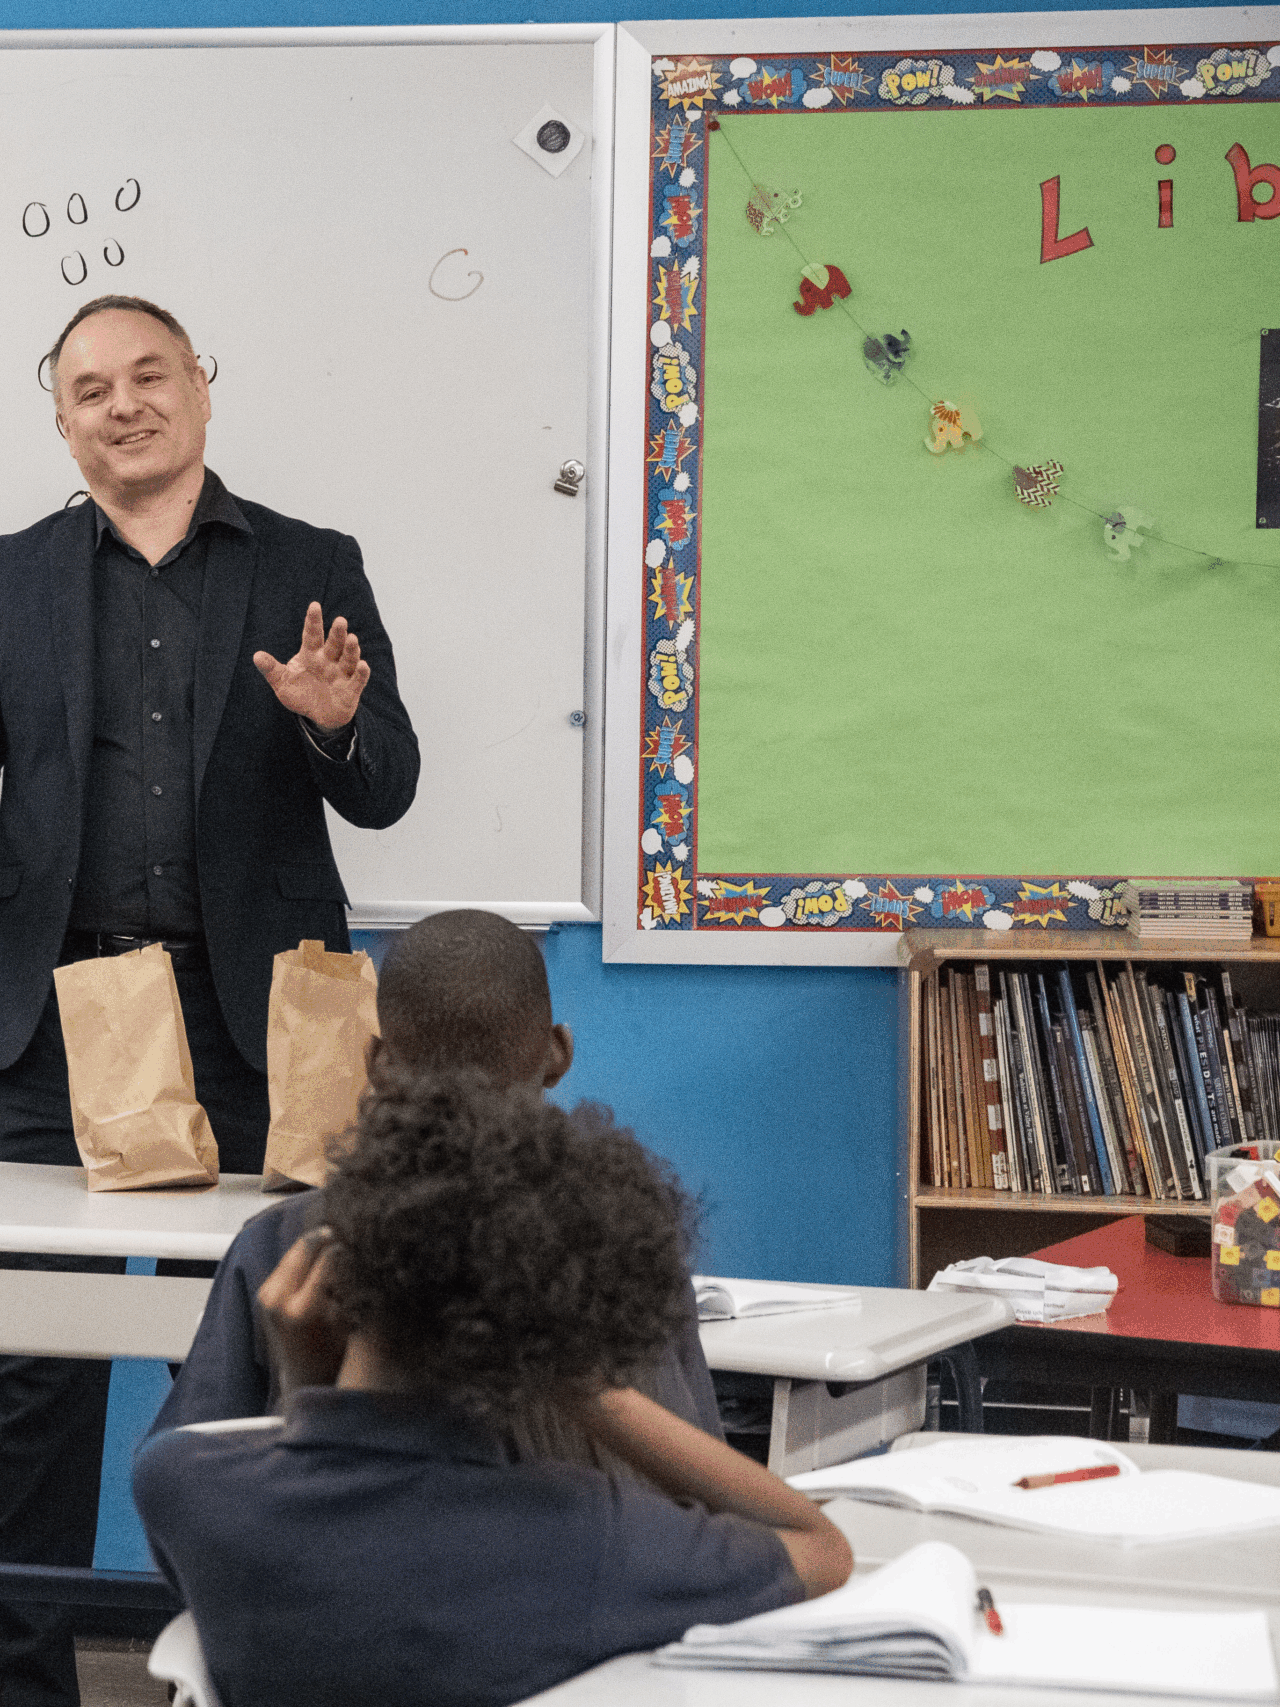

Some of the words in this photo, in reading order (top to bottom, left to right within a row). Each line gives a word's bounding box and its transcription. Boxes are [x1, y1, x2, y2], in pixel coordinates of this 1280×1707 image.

[667, 71, 712, 97] AMAZING!
[748, 71, 792, 100] WOW!
[824, 66, 863, 89] SUPER!
[886, 64, 940, 98] POW!
[1057, 66, 1102, 93] WOW!
[1136, 59, 1178, 82] SUPER!
[1201, 54, 1256, 88] POW!
[667, 195, 692, 239] WOW!
[658, 356, 690, 409] POW!
[661, 499, 688, 543] WOW!
[656, 652, 688, 706] POW!
[658, 794, 683, 838] WOW!
[654, 870, 679, 915] AMAZING!
[796, 888, 847, 920] POW!
[941, 889, 986, 915] WOW!
[1192, 1014, 1201, 1032] what
[1196, 1036, 1216, 1107] PRESIDENTS
[1212, 1122, 1222, 1143] made
